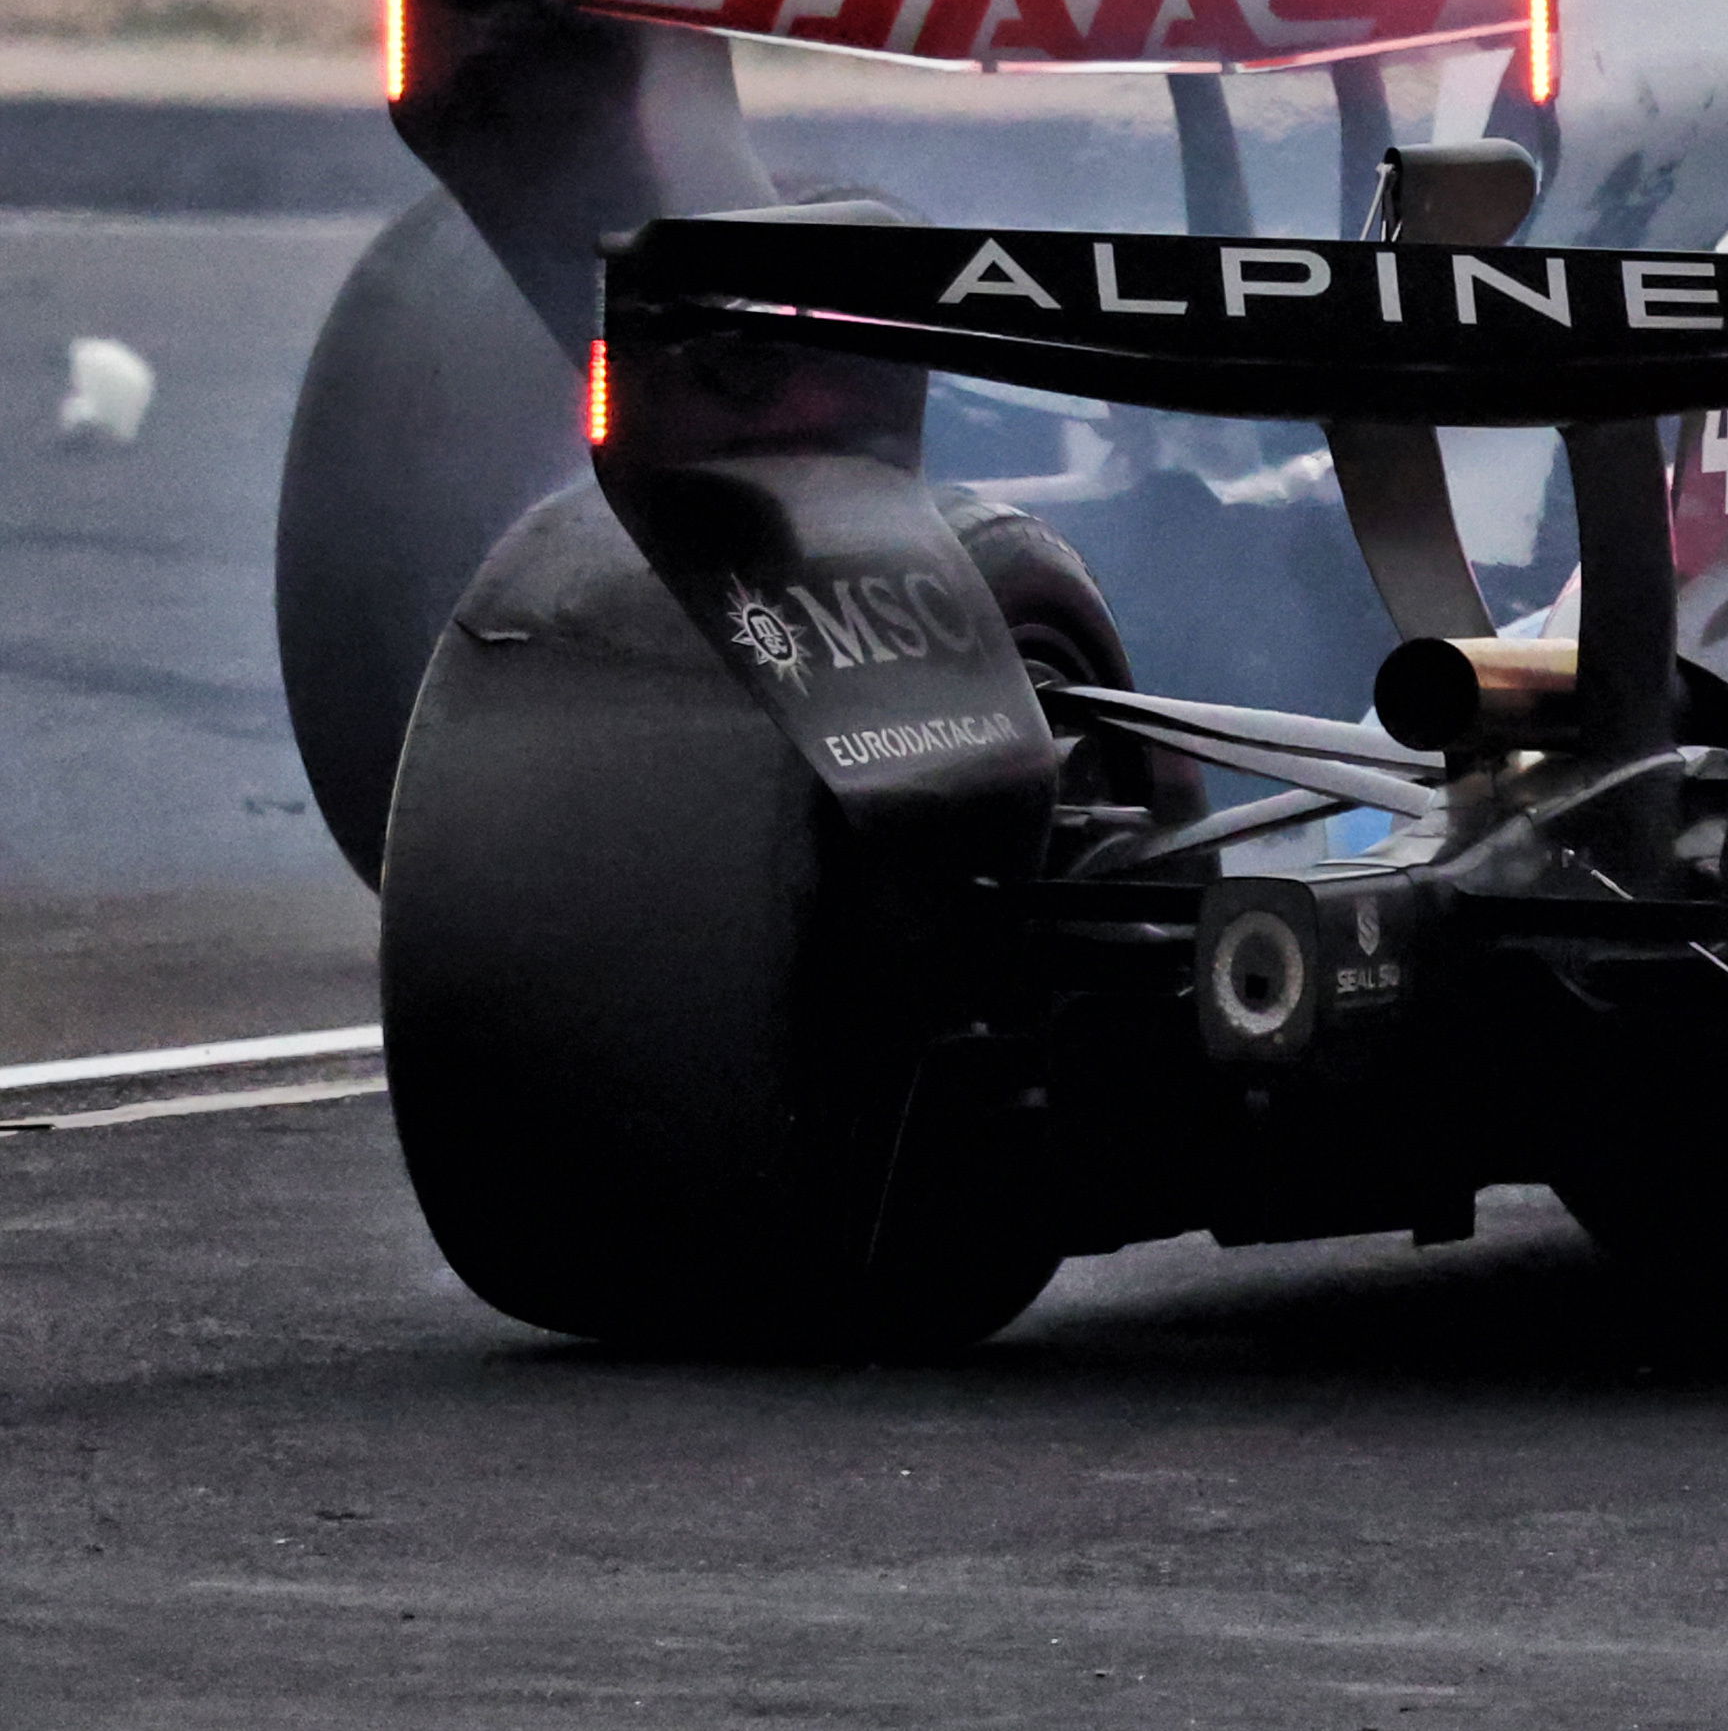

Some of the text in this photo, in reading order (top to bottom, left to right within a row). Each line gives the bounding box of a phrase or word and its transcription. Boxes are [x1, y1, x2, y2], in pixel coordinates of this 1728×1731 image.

[937, 237, 1726, 330] ALPINE
[785, 571, 984, 670] MSC
[823, 712, 1020, 768] EURODATACAR
